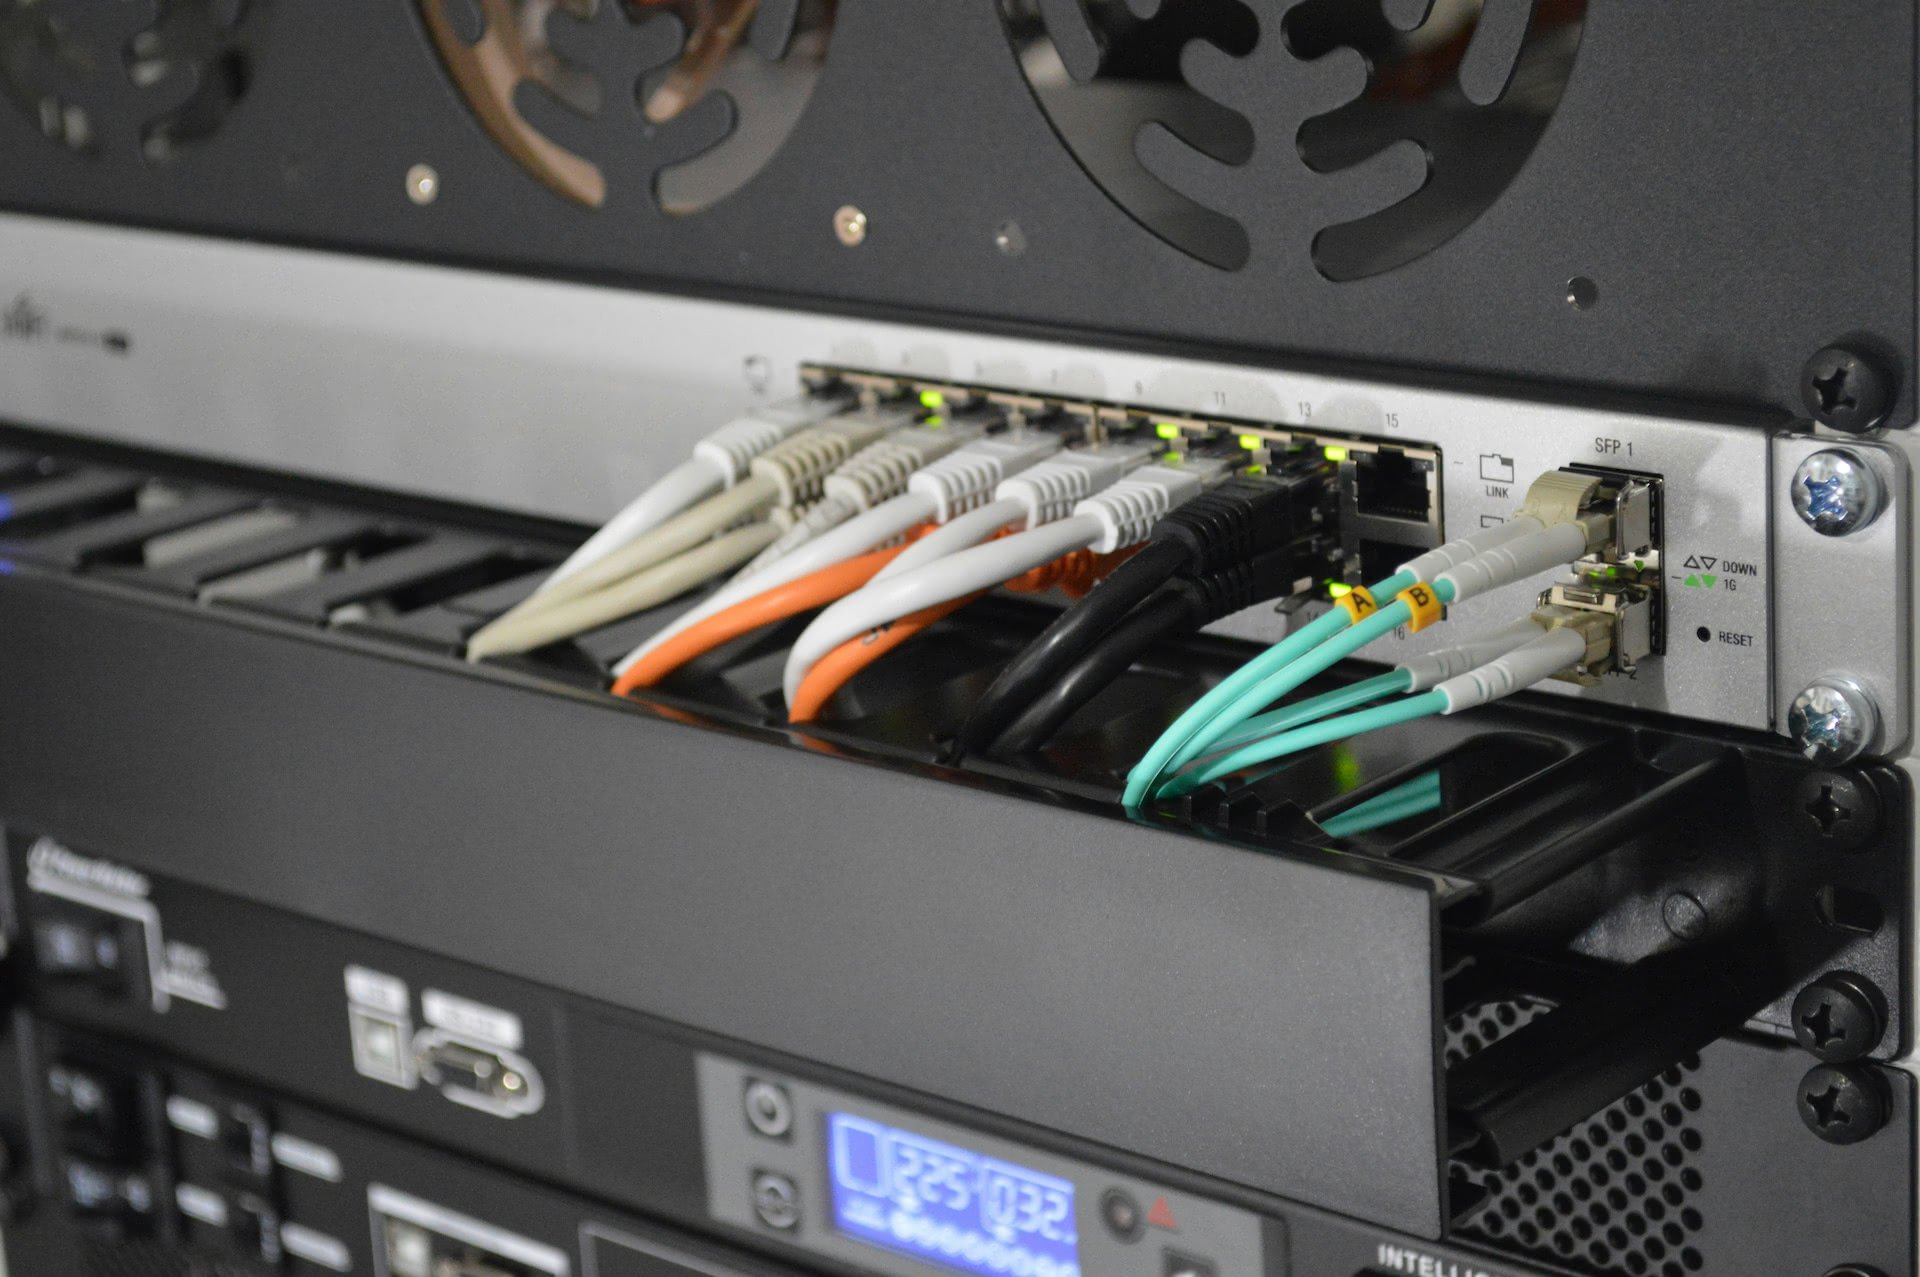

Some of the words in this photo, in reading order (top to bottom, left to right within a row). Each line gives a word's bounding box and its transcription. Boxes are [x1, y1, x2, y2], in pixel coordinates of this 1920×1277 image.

[1213, 390, 1227, 407] 11
[1299, 401, 1312, 418] 13
[1385, 412, 1399, 429] 15
[1595, 436, 1621, 455] SFP
[1627, 441, 1633, 457] 1
[1486, 485, 1509, 499] LINK
[1723, 560, 1757, 576] DOWN
[1724, 579, 1737, 591] 1G
[1351, 591, 1373, 613] A
[1408, 586, 1430, 608] B
[1719, 630, 1753, 647] RESET
[892, 1147, 971, 1212] 225
